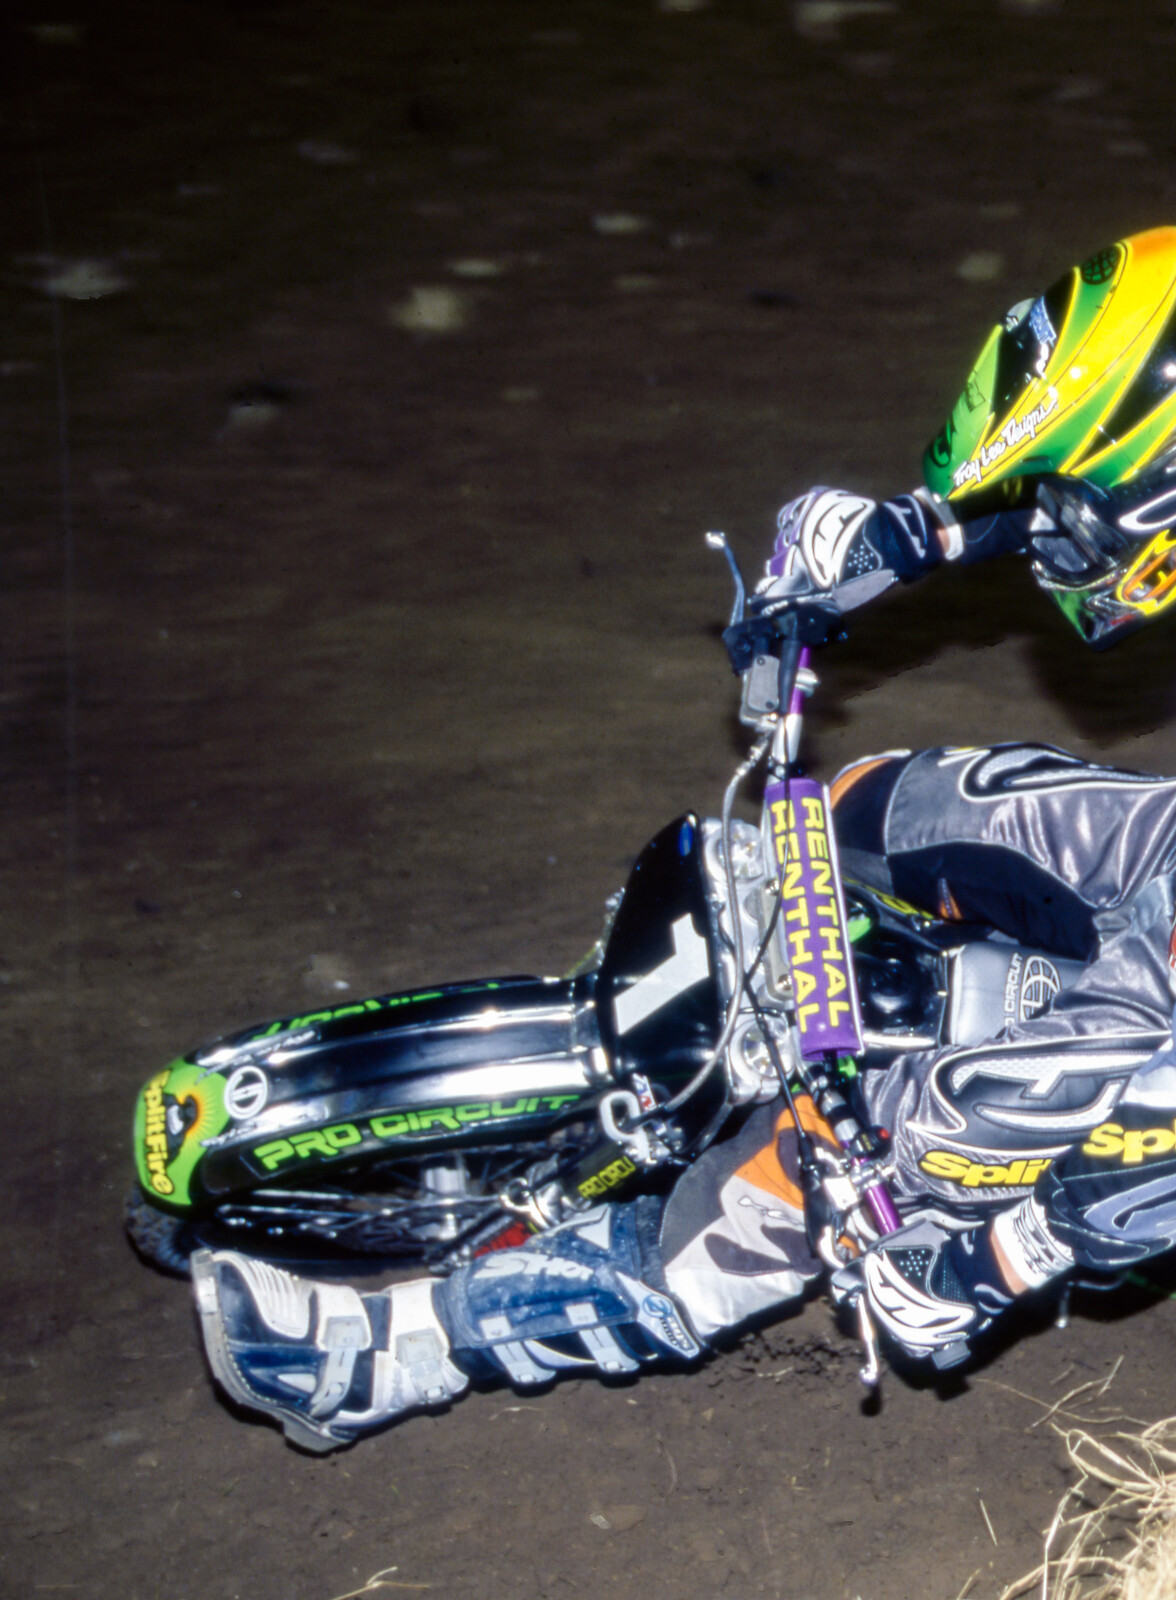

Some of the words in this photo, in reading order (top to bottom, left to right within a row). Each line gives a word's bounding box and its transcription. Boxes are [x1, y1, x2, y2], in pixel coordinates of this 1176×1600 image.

[953, 459, 982, 487] Troy
[981, 441, 1006, 468] Lee
[613, 912, 711, 1037] 1
[770, 799, 821, 1033] RENTHAL
[800, 797, 850, 1028] RENTHAL
[253, 1123, 362, 1171] PRO
[369, 1094, 580, 1138] CIRCUIT
